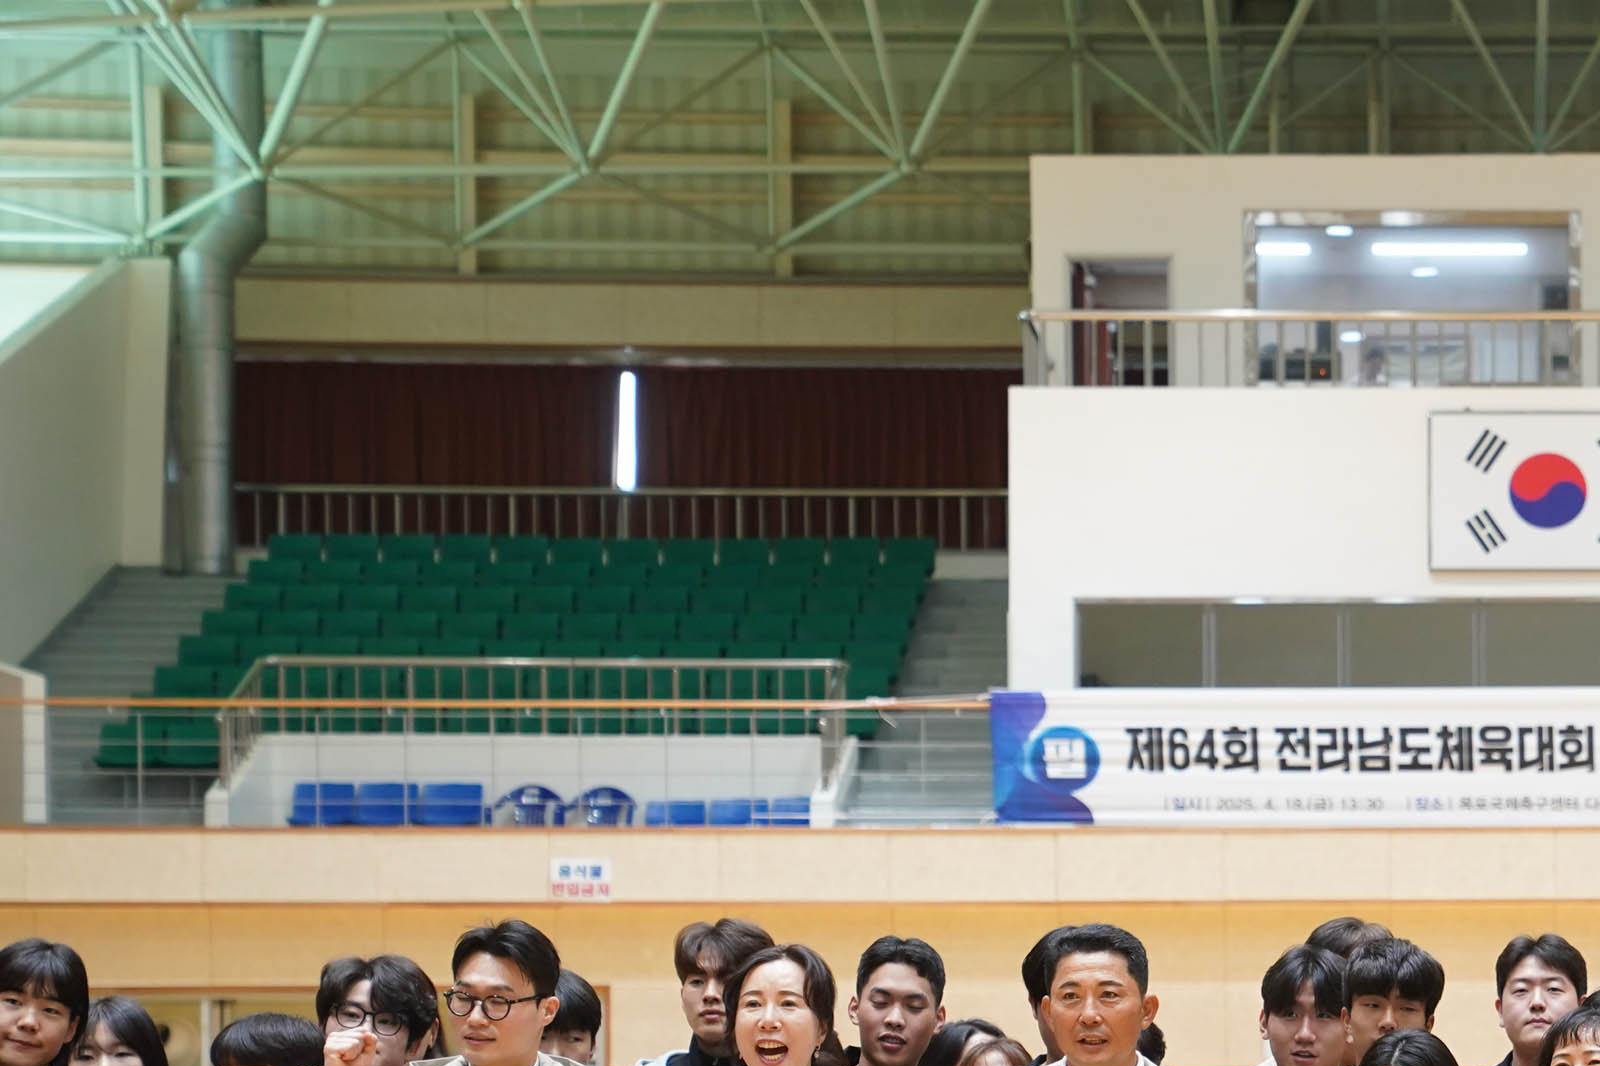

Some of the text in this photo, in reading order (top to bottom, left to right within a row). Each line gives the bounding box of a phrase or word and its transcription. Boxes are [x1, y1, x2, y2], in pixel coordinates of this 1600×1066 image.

[1042, 738, 1086, 779] 필
[1124, 726, 1259, 772] 제64회
[1274, 725, 1595, 772] 전라남도체육대회
